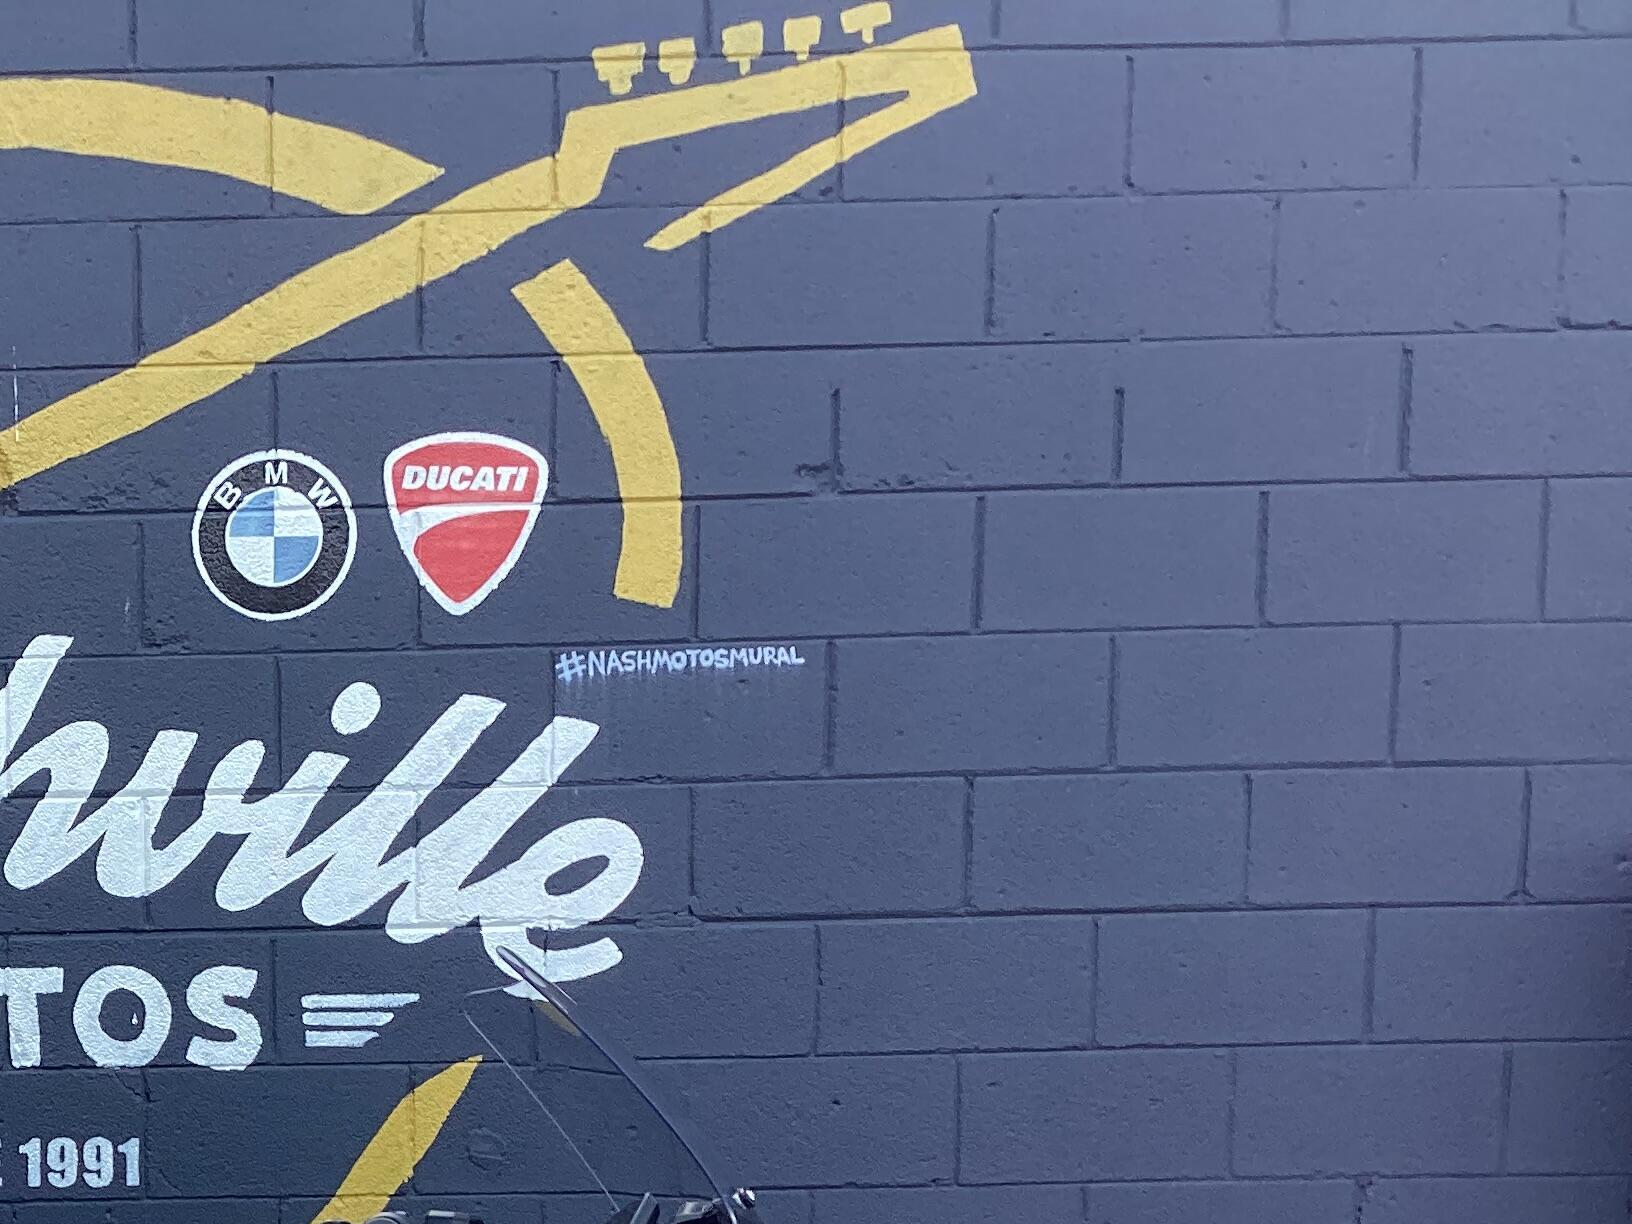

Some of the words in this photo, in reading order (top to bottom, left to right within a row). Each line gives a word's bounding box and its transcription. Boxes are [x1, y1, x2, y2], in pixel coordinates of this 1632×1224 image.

[213, 461, 339, 510] BMW
[402, 465, 529, 492] DUCATI
[555, 646, 806, 682] #NASHMOTOSMURAL
[18, 1136, 140, 1188] 1991
